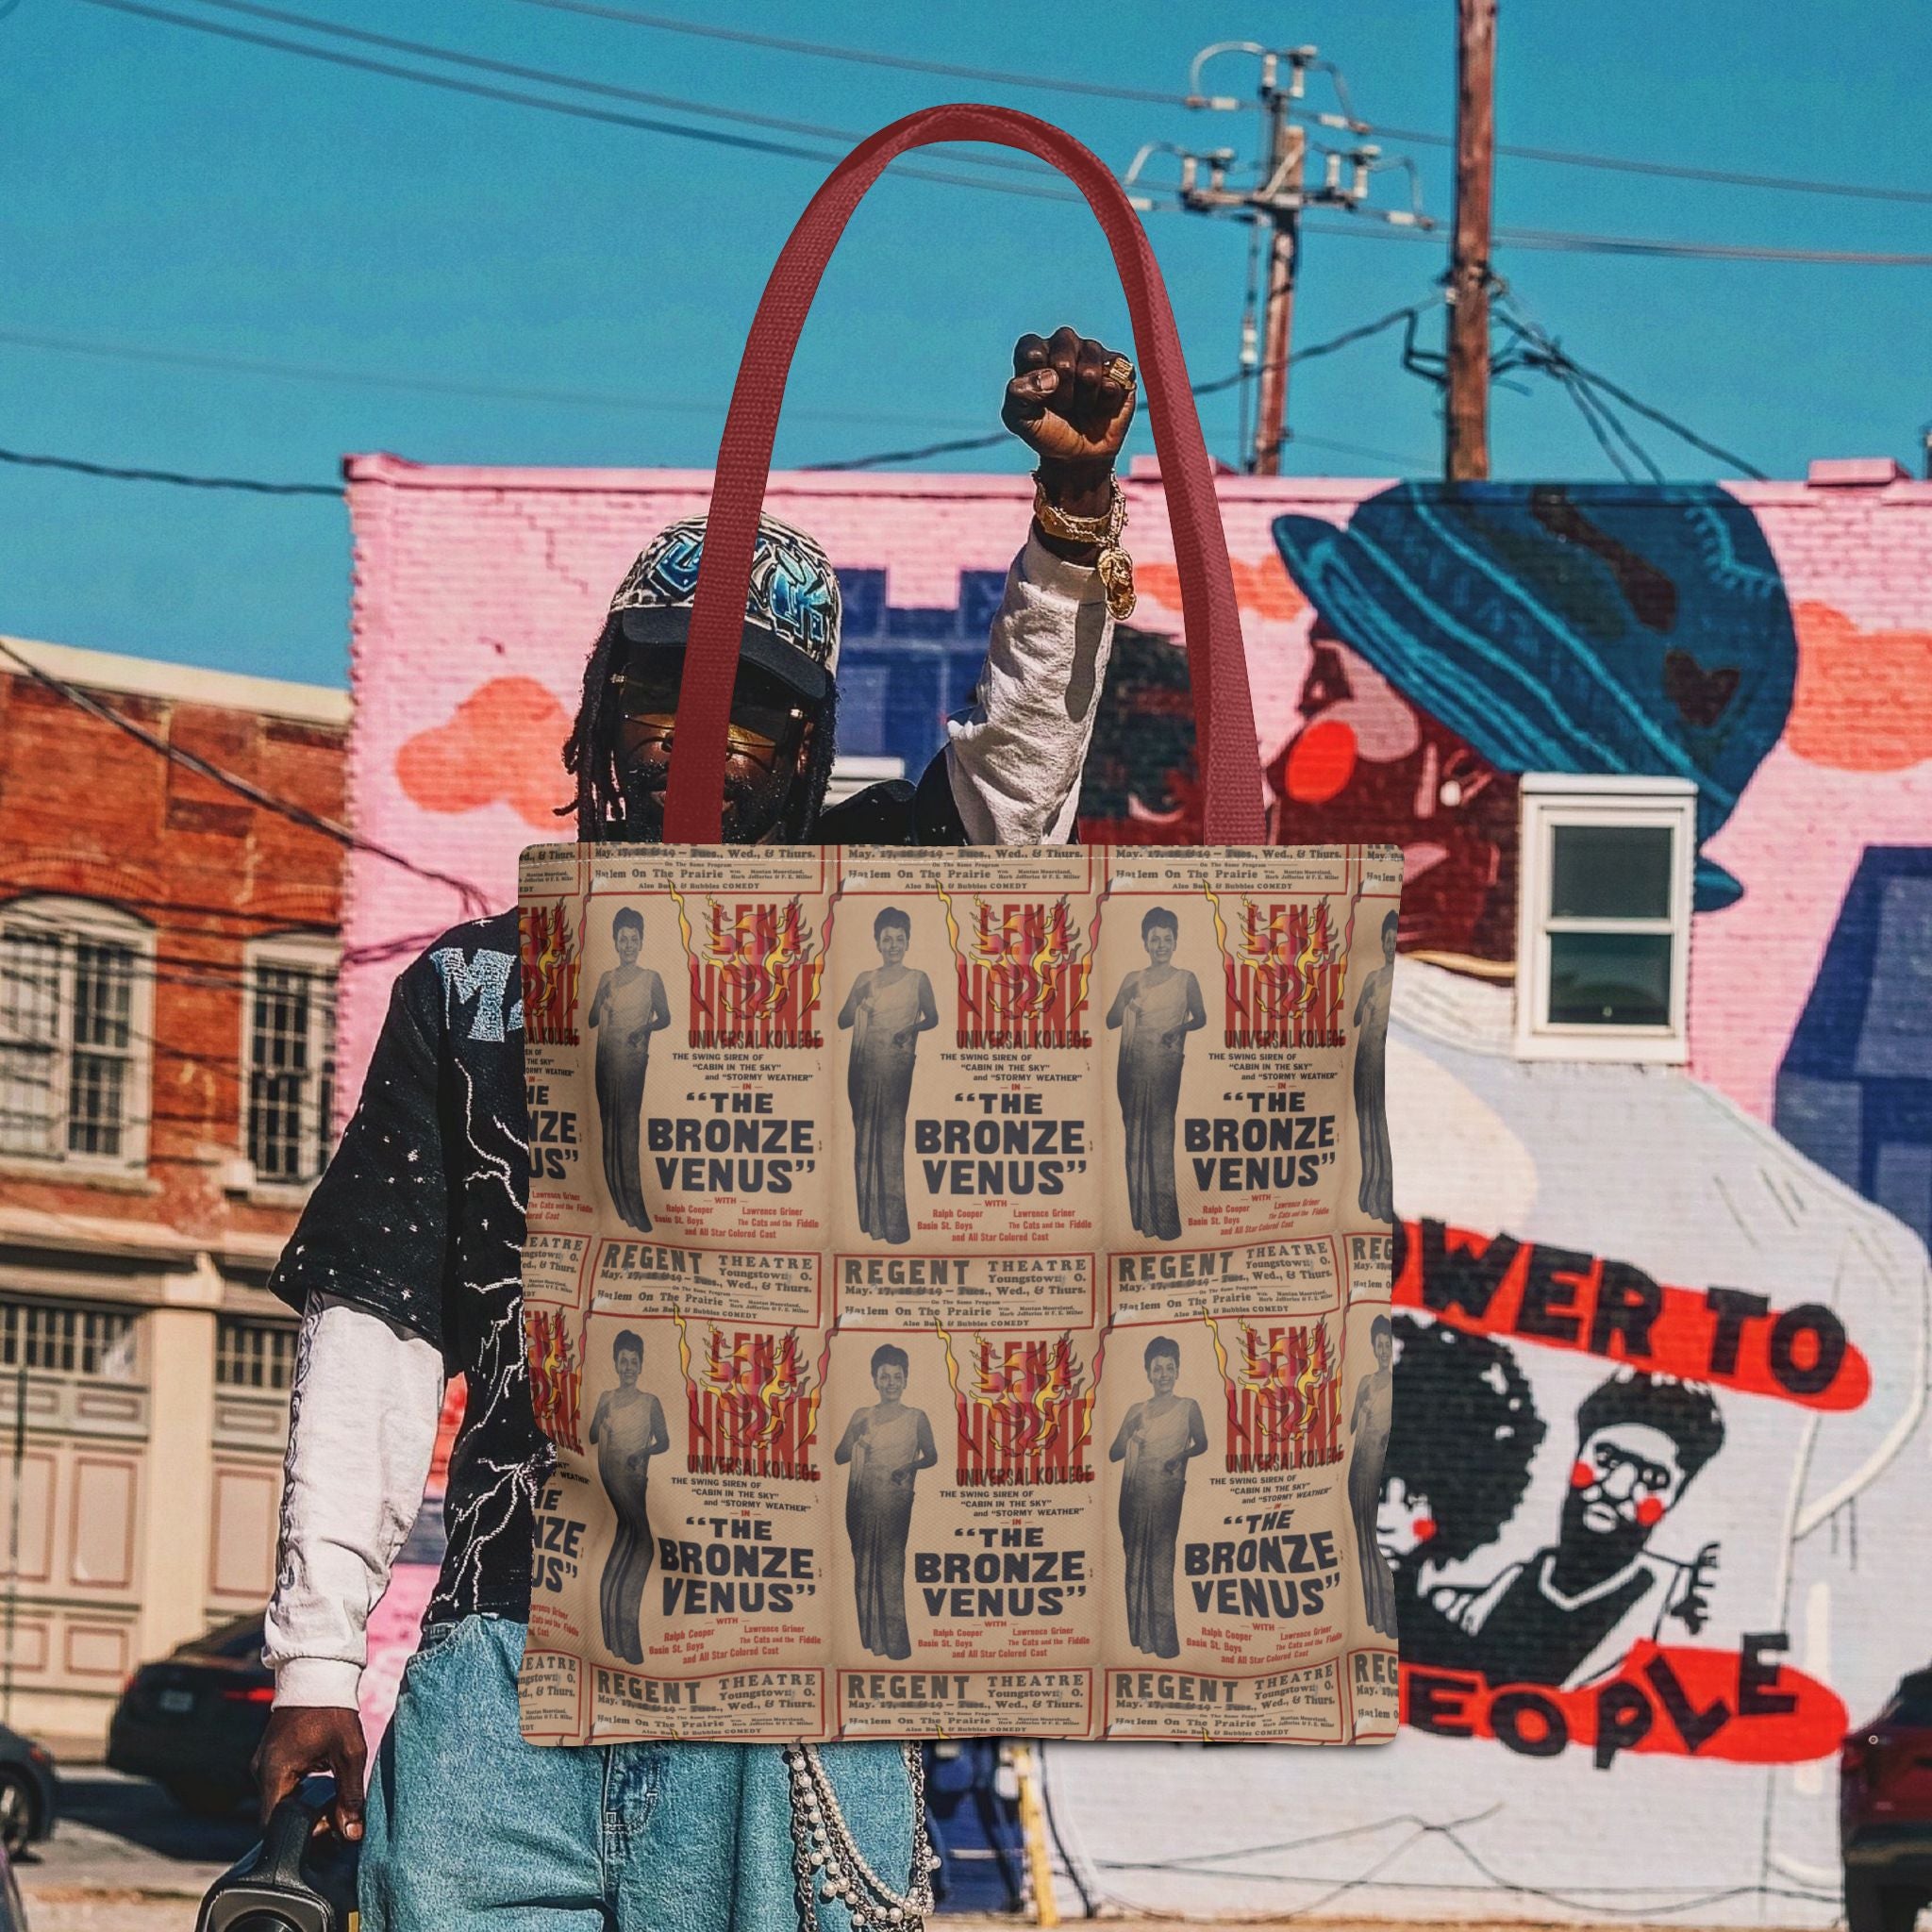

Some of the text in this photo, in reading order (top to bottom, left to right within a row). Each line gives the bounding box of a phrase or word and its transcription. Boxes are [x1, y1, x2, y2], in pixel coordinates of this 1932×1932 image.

[897, 868, 991, 878] On The Prairie
[648, 1118, 814, 1154] BRONZE
[915, 1120, 1085, 1155] BRONZE
[1185, 1115, 1336, 1153] BRONZE
[933, 1209, 983, 1219] Ralph Cooper
[1013, 1208, 1075, 1218] Lawrence Griner
[1024, 1221, 1041, 1229] Cats
[1070, 1220, 1092, 1228] Fiddle
[917, 1222, 973, 1231] Basin St. Boys
[969, 1233, 977, 1241] All
[981, 1233, 997, 1241] Star
[999, 1233, 1028, 1241] Colored
[1032, 1232, 1049, 1241] Cast
[602, 1243, 812, 1274] REGENT THEATRE
[1119, 1242, 1328, 1282] REGENT THEATRE
[845, 1259, 1086, 1285] REGENT THEATRE
[1074, 1274, 1087, 1282] O.
[1049, 1286, 1086, 1294] Thurs.
[947, 1307, 991, 1316] Prairie
[1392, 1214, 1846, 1394] WER TO
[658, 1538, 813, 1579] BRONZE
[1185, 1531, 1338, 1576] BRONZE
[915, 1550, 1085, 1584] BRONZE
[597, 1670, 815, 1704] REGENT THEATRE
[848, 1674, 1083, 1699] REGENT THEATRE
[1116, 1665, 1333, 1702] REGENT THEATRE
[1046, 1700, 1083, 1708] Thurs.
